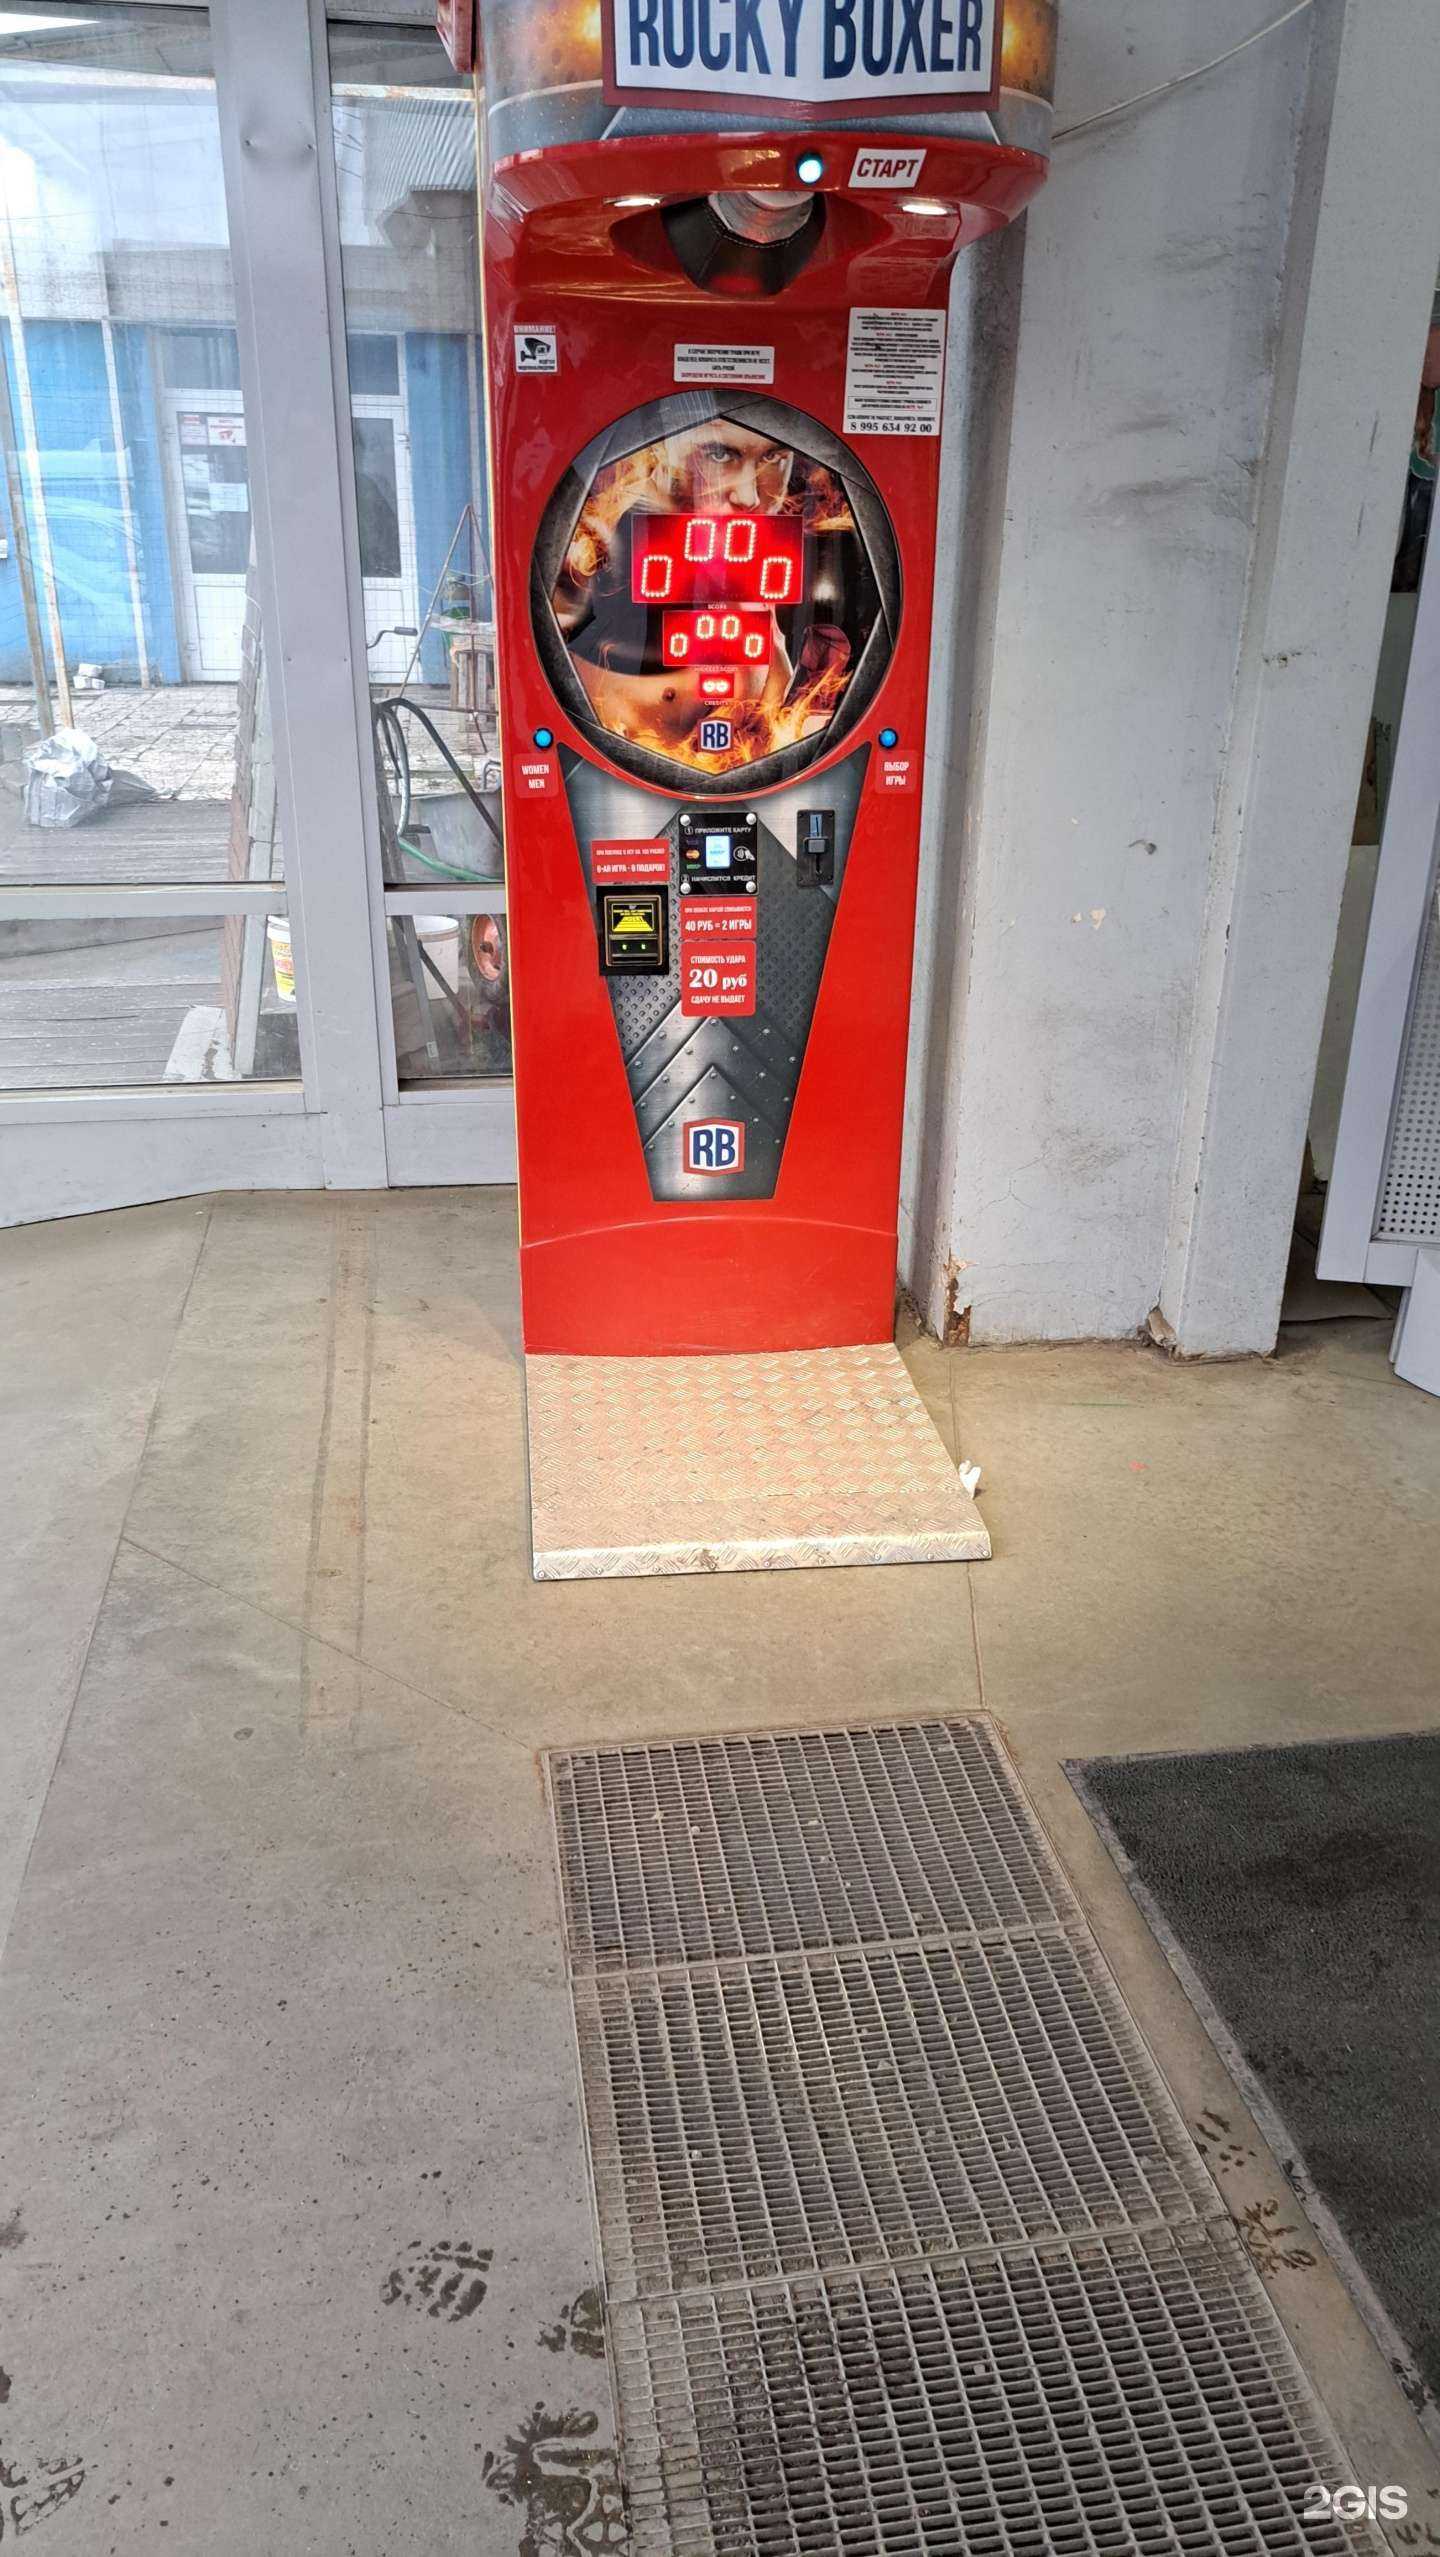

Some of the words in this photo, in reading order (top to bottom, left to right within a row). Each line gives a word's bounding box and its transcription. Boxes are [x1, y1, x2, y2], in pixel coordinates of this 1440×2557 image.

[629, 0, 804, 77] ROCKY
[823, 0, 983, 79] BOXER
[857, 158, 919, 178] СТАРТ
[850, 422, 857, 431] 8
[860, 422, 879, 431] 995
[881, 423, 900, 432] 634
[904, 424, 917, 432] 92
[919, 424, 933, 432] 00
[703, 723, 729, 749] RB
[521, 764, 550, 775] WOMEN
[883, 761, 909, 771] ВЫБОР
[528, 778, 545, 789] MEN
[885, 775, 906, 785] ИГРЫ
[685, 920, 696, 931] 40
[697, 920, 714, 931] РУБ
[722, 920, 728, 931] 2
[729, 919, 752, 930] ИГРЫ
[689, 969, 718, 988] 20
[722, 974, 748, 990] руб
[693, 1128, 735, 1167] RB
